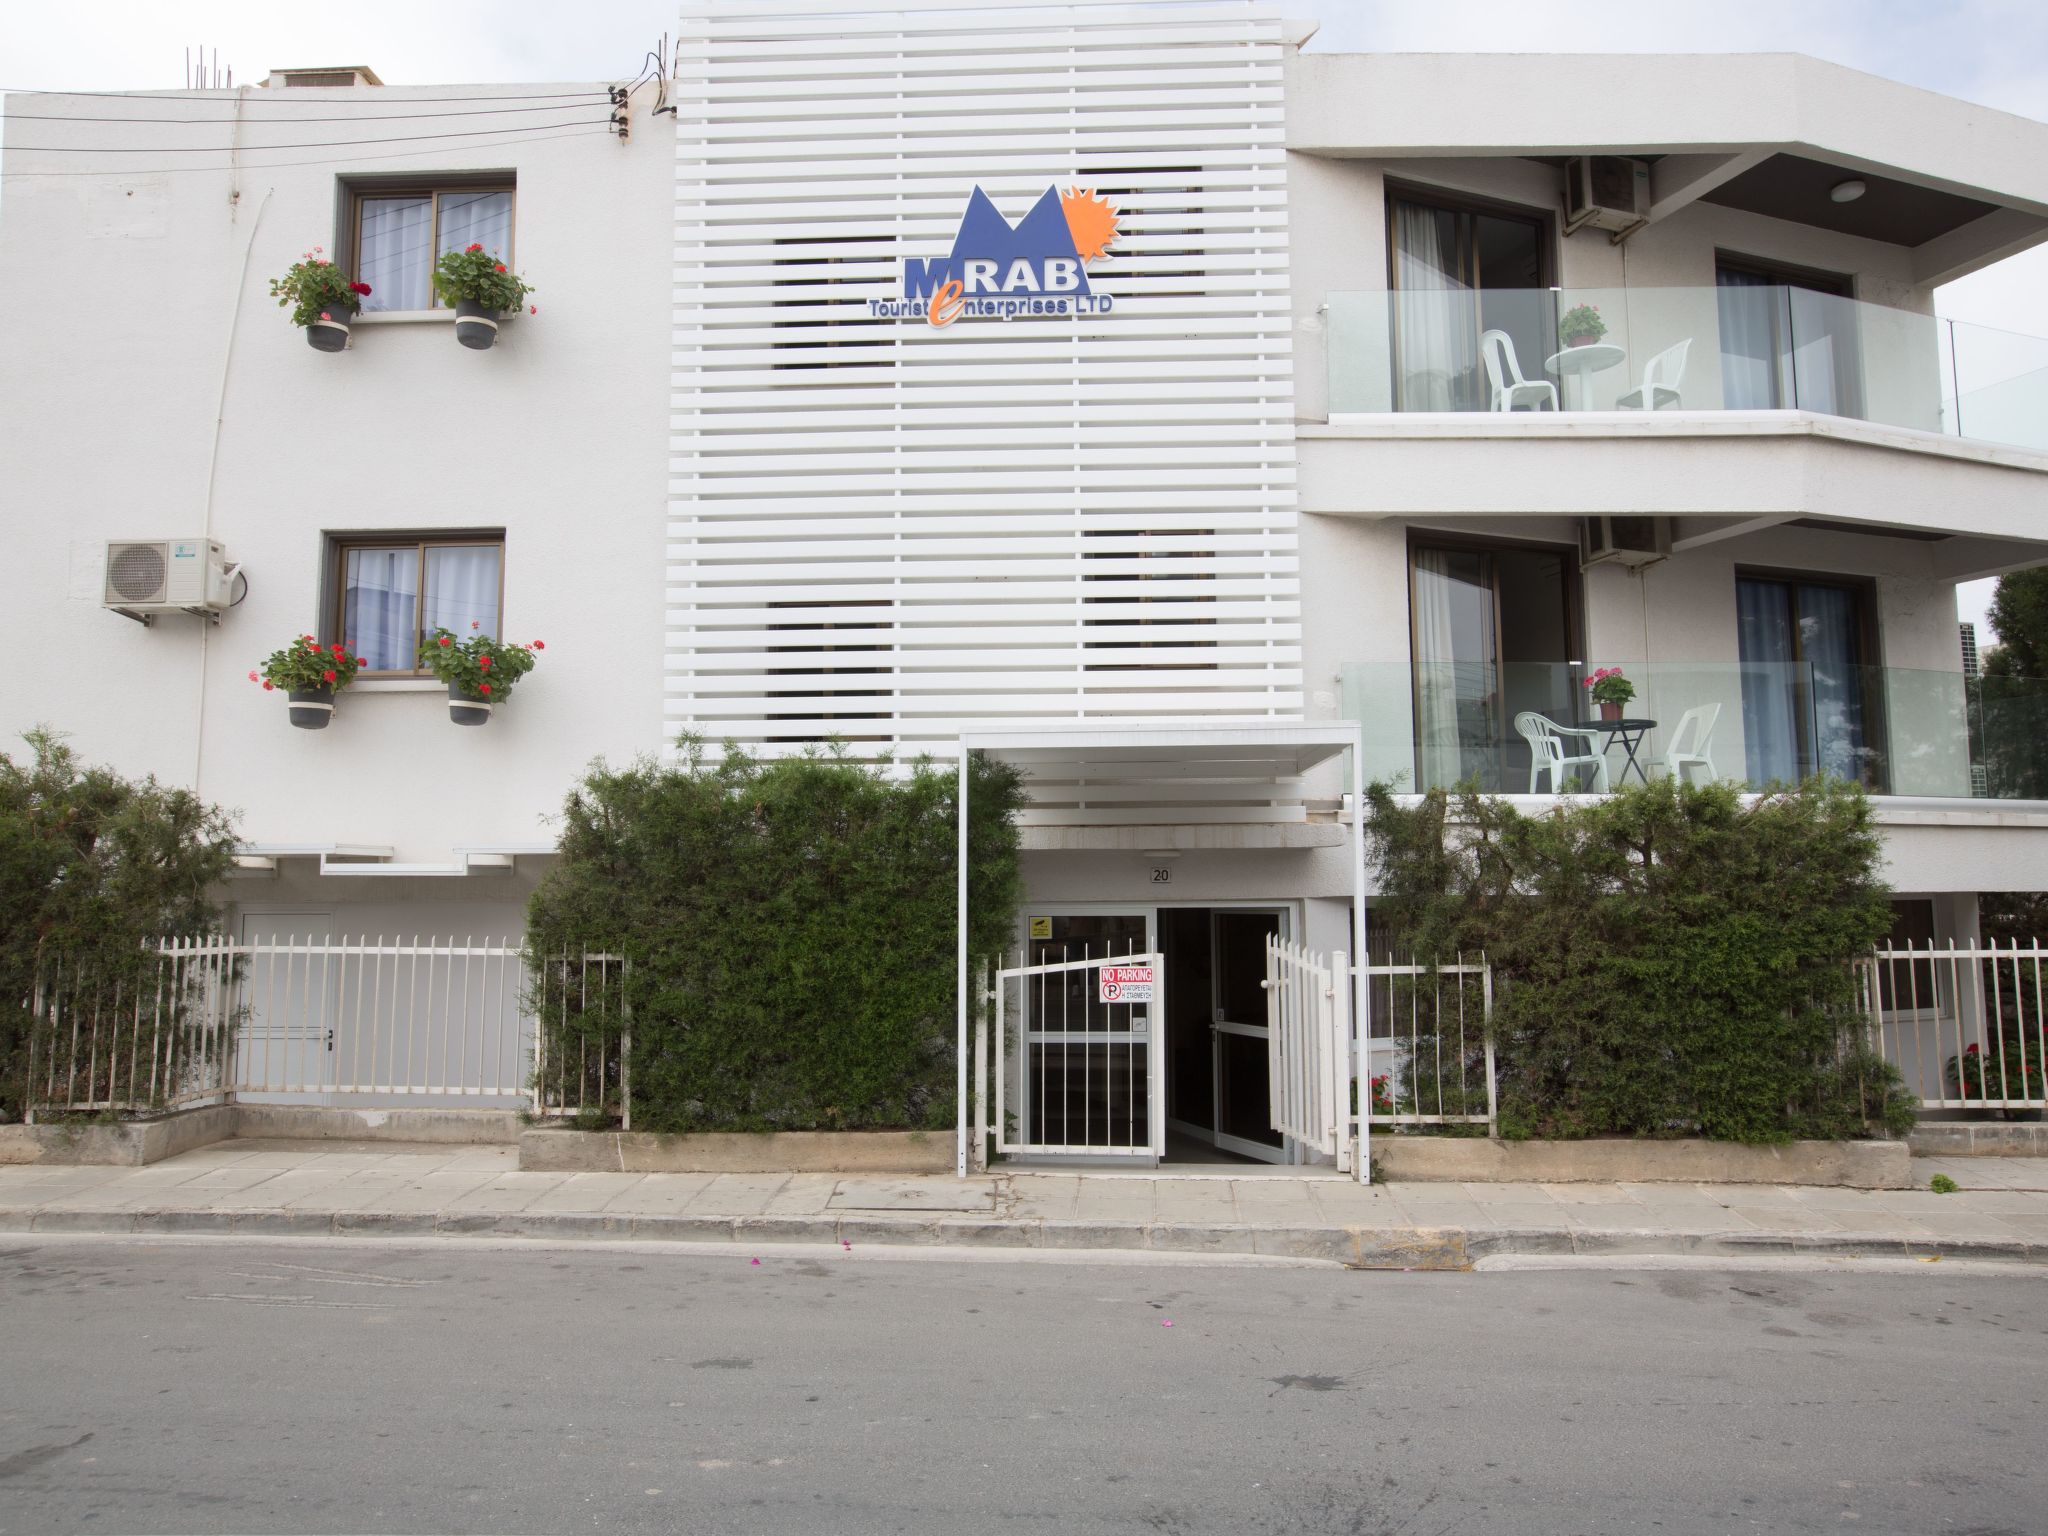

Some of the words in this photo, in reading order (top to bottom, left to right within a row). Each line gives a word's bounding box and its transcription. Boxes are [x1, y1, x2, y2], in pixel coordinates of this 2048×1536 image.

[869, 299, 929, 316] Tourist
[1075, 295, 1113, 313] LTD
[1153, 869, 1169, 881] 20
[1102, 969, 1115, 981] NO
[1117, 969, 1152, 981] PARKING
